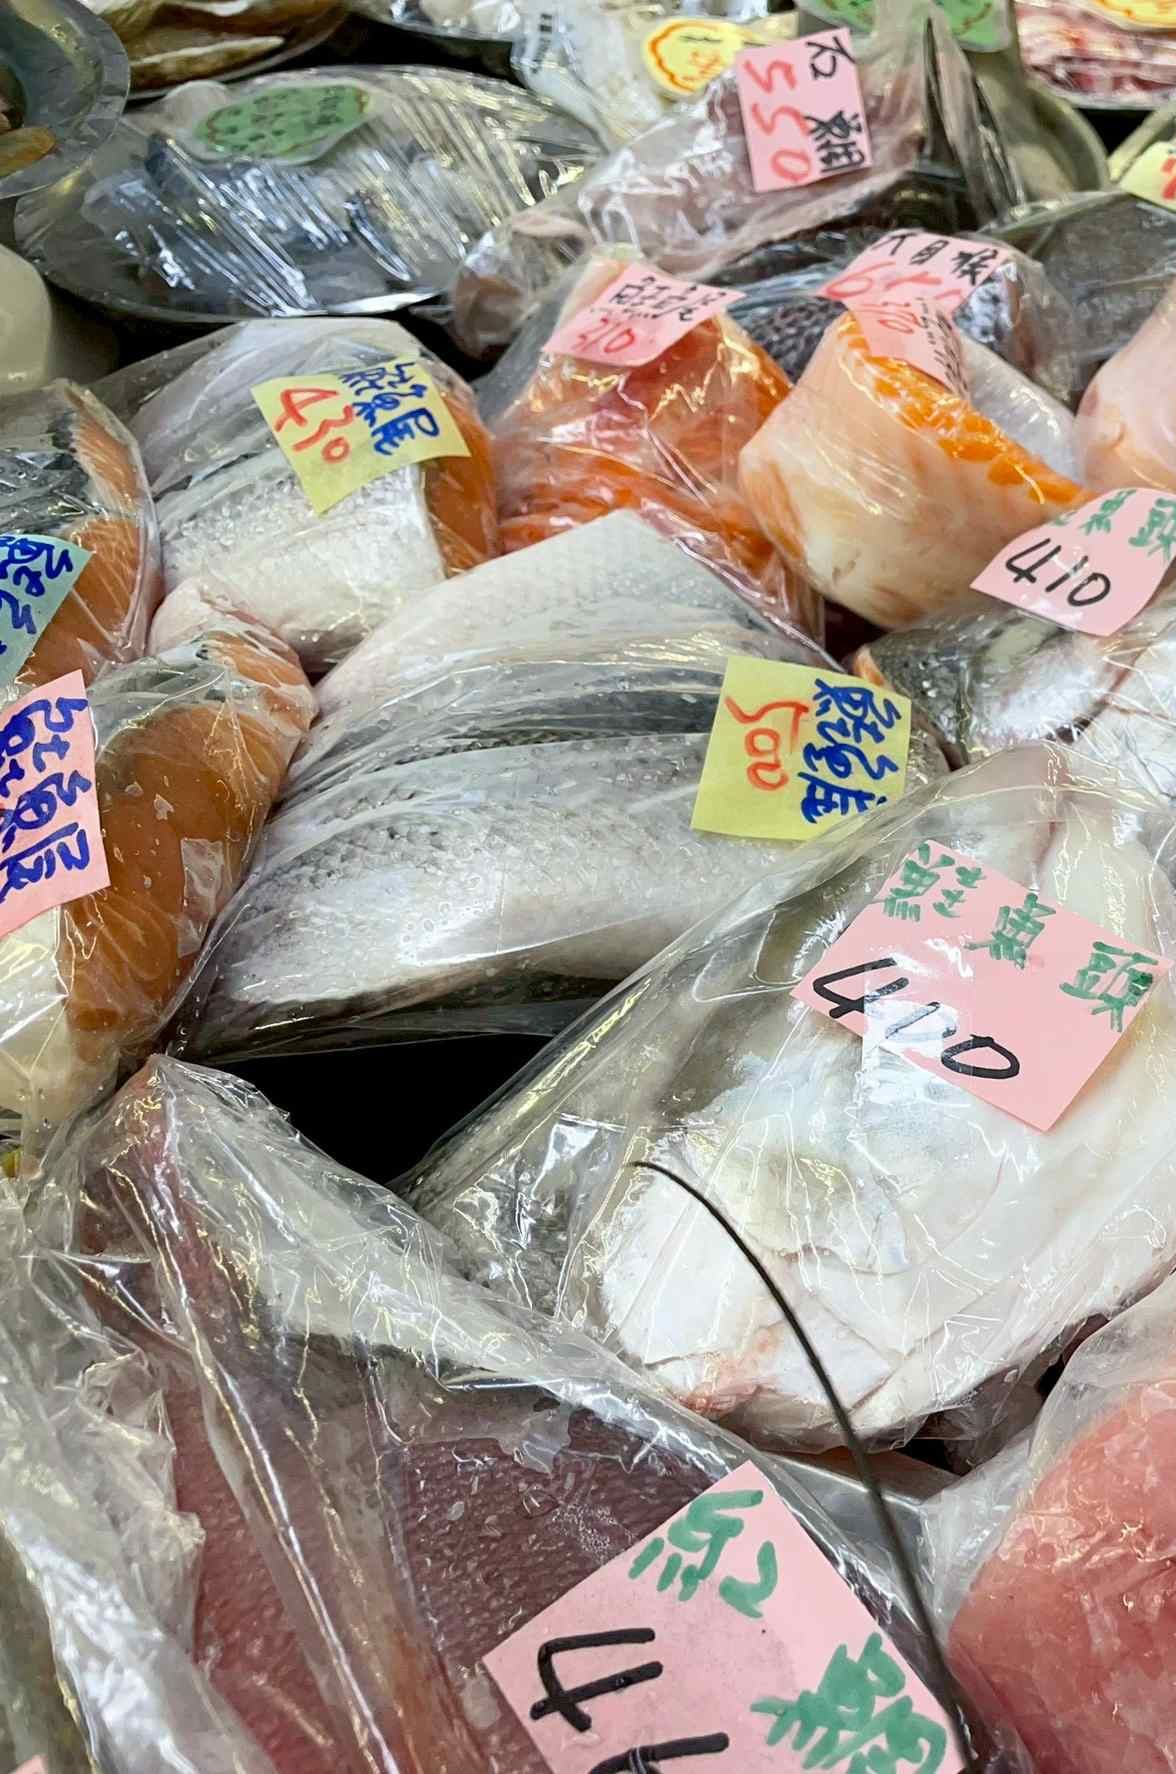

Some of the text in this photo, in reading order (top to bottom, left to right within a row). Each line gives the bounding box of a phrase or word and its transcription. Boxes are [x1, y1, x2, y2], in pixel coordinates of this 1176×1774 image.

[743, 59, 812, 183] 550
[273, 386, 356, 466] 430
[1004, 537, 1112, 607] 410
[724, 695, 810, 793] 500
